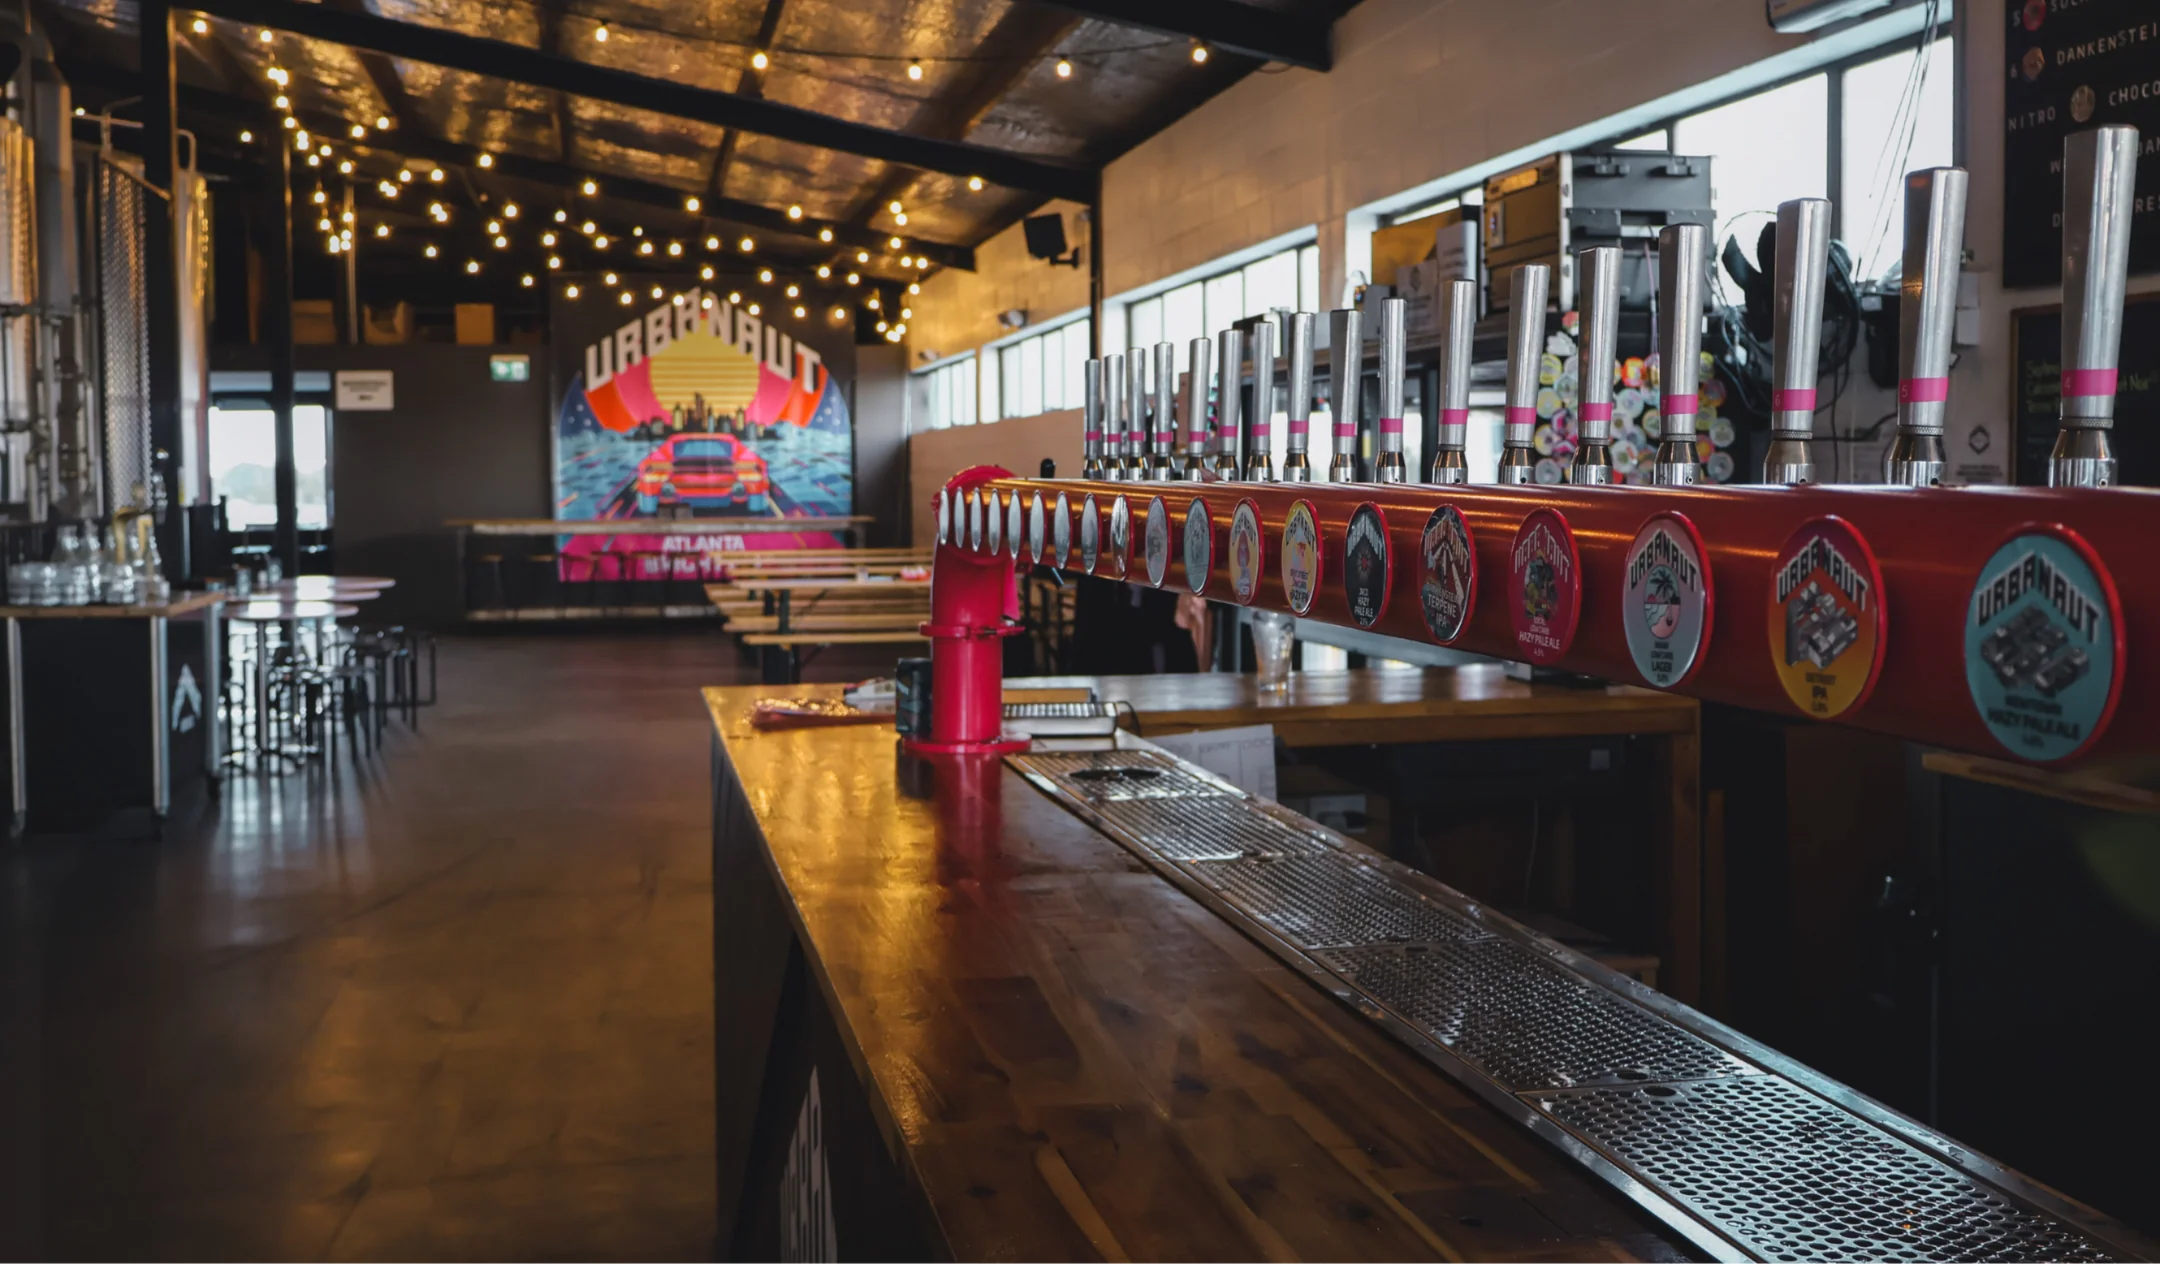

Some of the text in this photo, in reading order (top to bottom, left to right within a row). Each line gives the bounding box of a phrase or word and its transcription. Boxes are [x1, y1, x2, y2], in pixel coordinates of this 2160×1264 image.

[2056, 22, 2158, 66] DANKENSTEI
[2008, 79, 2160, 131] NITRO CHOCO
[585, 286, 821, 394] URBANAUT
[662, 534, 745, 552] ATLANTA
[1628, 528, 1699, 592] URBANAUT
[1776, 535, 1869, 612] URBANAUT
[1428, 593, 1457, 618] TERPENE
[1974, 550, 2103, 645] URBANAUT
[1435, 613, 1447, 629] IPA
[1518, 630, 1561, 650] HAZY PALE ALE
[1651, 661, 1673, 673] LAGER
